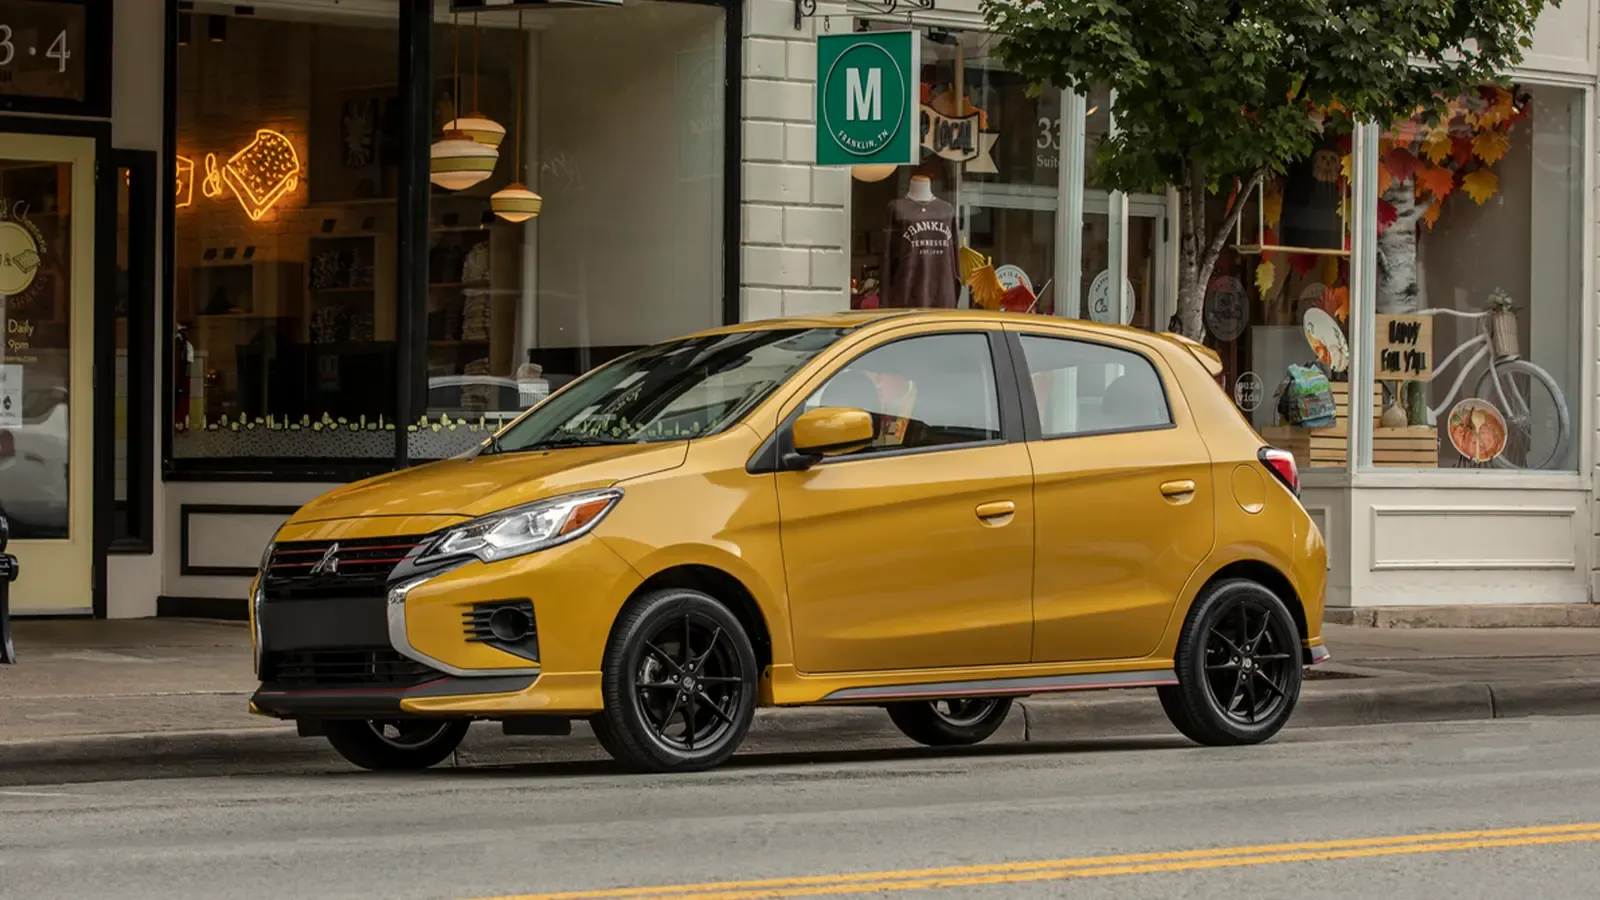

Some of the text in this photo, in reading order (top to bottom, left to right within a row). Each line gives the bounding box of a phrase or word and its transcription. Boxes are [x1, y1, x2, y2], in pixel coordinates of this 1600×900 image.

[845, 67, 882, 121] M
[877, 129, 889, 142] TN
[1036, 154, 1061, 168] Suit
[8, 318, 34, 336] Daily
[7, 339, 29, 352] 9pm
